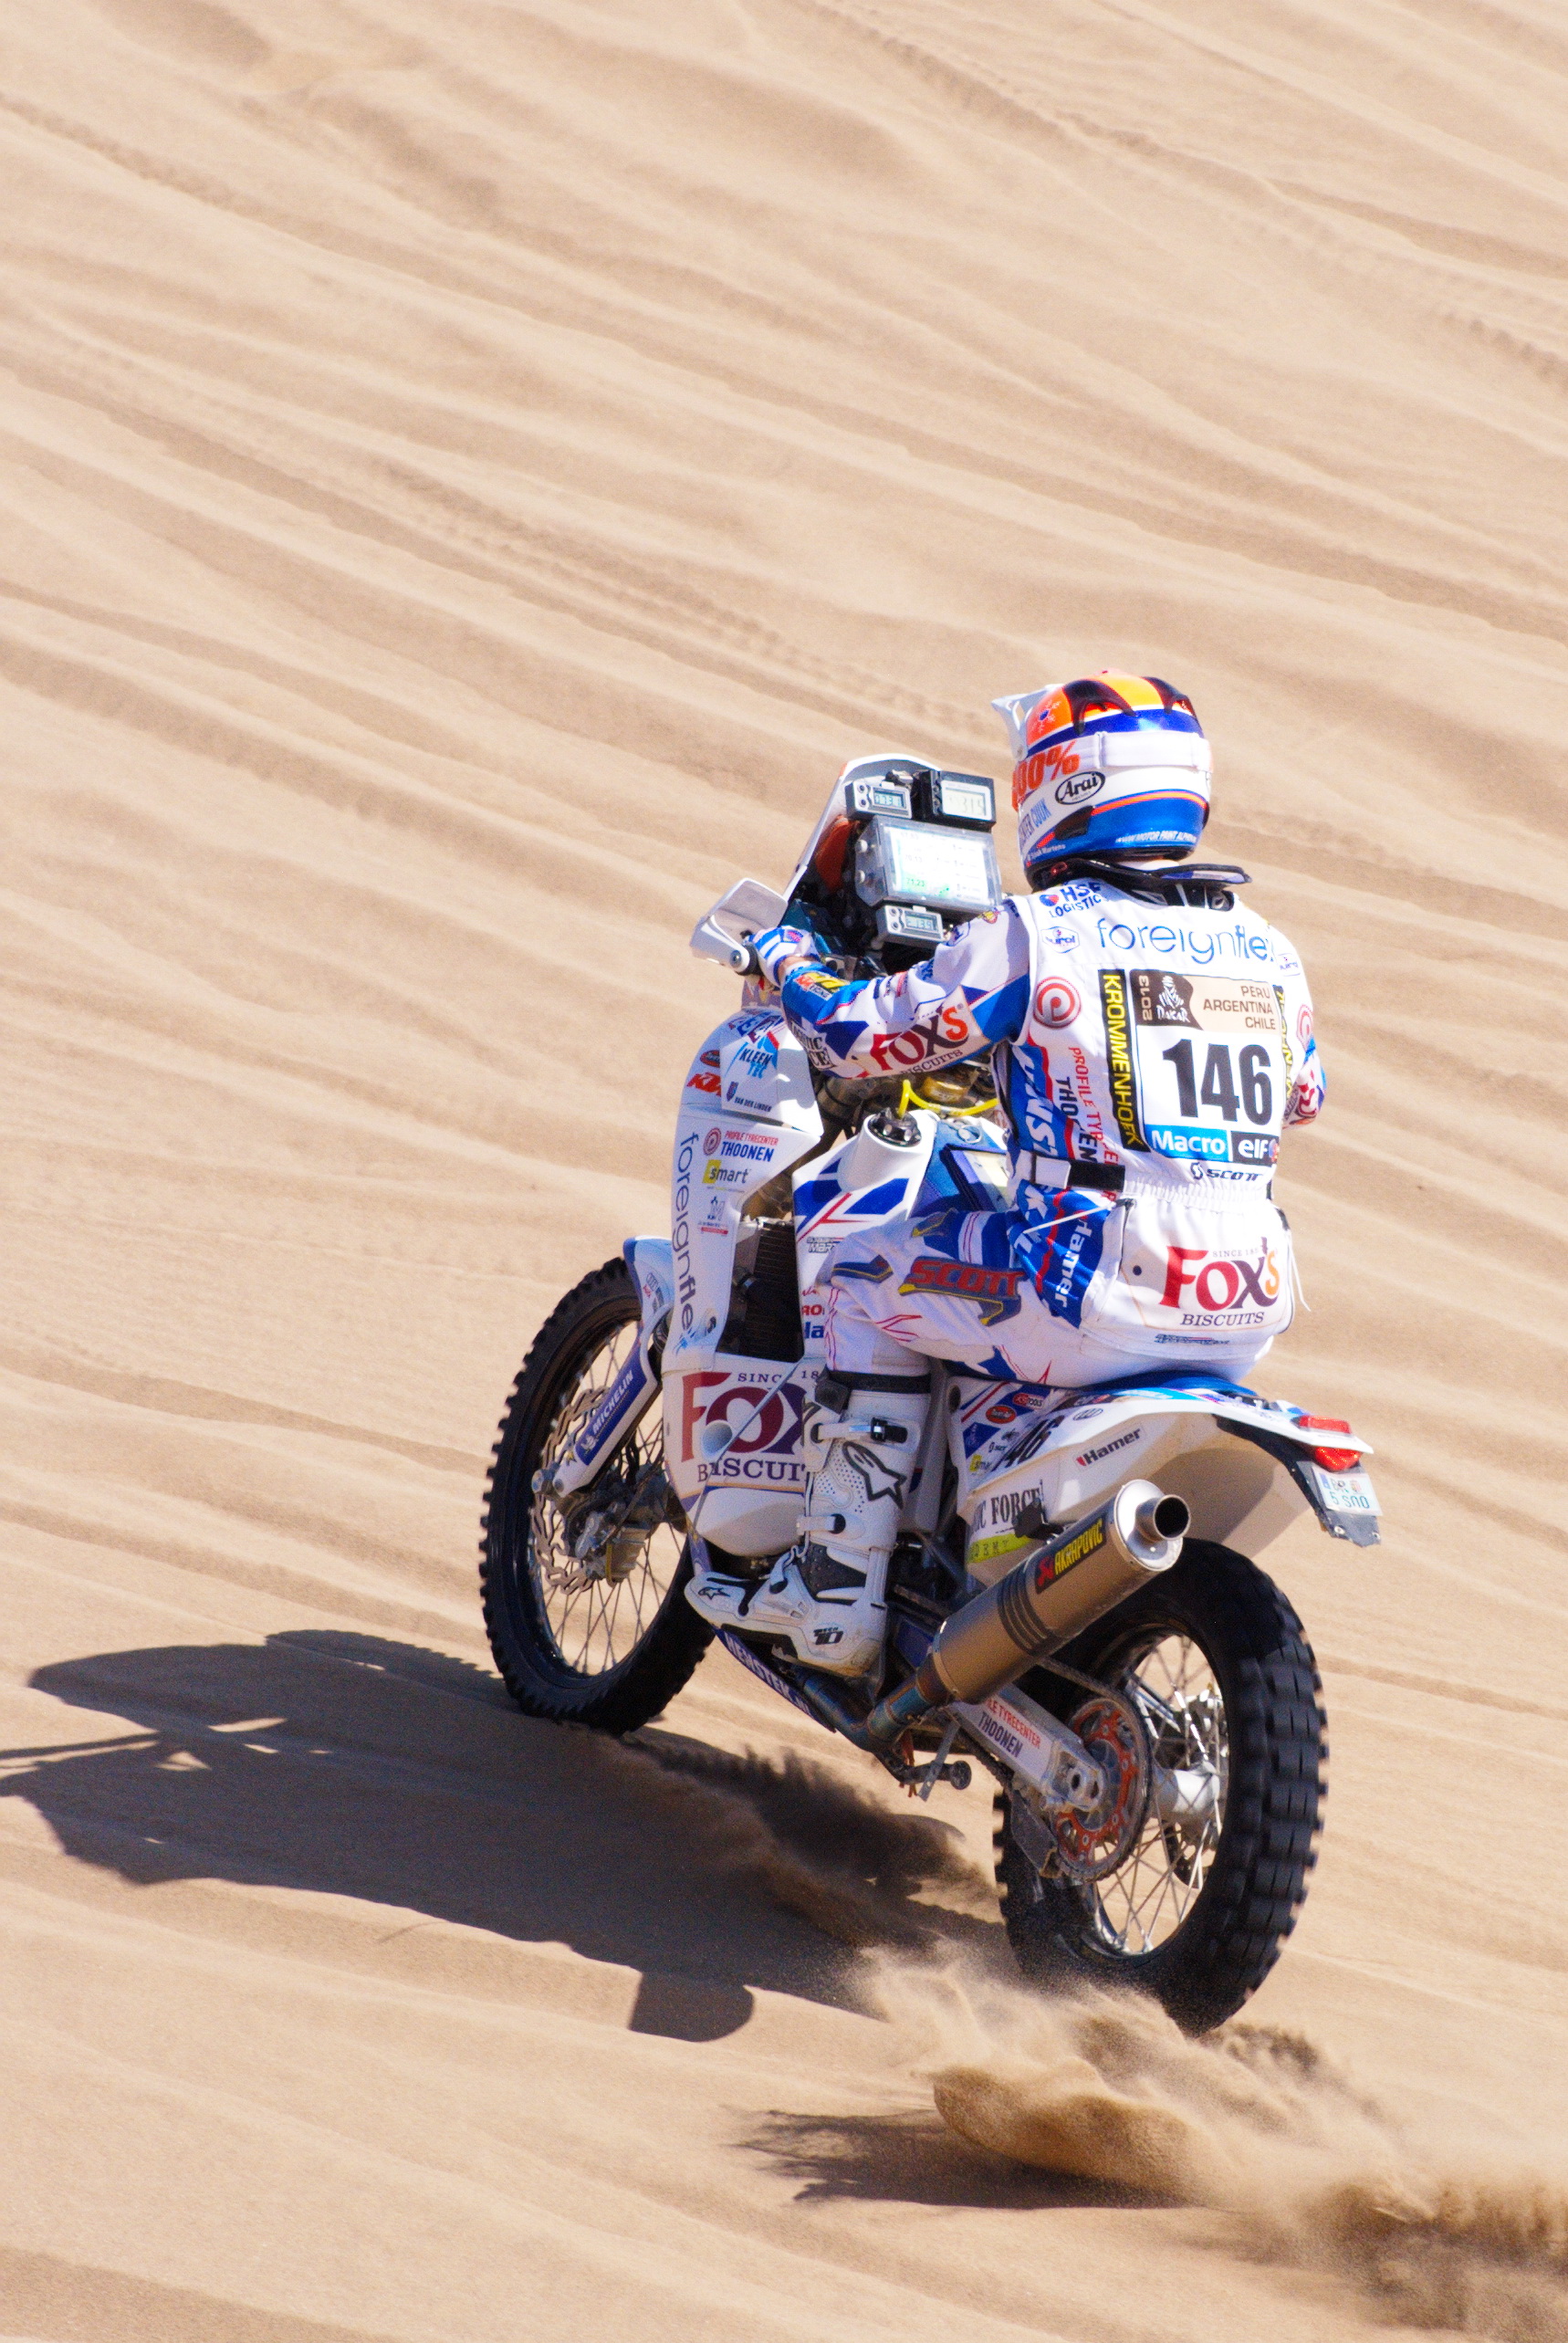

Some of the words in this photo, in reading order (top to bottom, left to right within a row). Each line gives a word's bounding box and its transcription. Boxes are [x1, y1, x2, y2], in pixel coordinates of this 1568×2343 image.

[1060, 771, 1099, 796] Arai
[1240, 985, 1271, 999] PERU
[1203, 998, 1274, 1016] ARGENTINA
[1245, 1016, 1276, 1030] CHILE
[739, 1048, 771, 1069] KLEEN
[1069, 1046, 1096, 1108] PROFILE
[1162, 1038, 1272, 1127] 146
[721, 1142, 775, 1162] THOONEN
[1152, 1129, 1227, 1156] Macro
[1238, 1137, 1269, 1159] elf
[710, 1167, 749, 1184] smart
[912, 1260, 1026, 1296] SCOTT
[1179, 1312, 1265, 1327] BISCUITS
[737, 1372, 785, 1383] SINC
[592, 1369, 634, 1436] MICHELIN
[1085, 1427, 1142, 1466] Hamer
[697, 1458, 806, 1483] BISCUI
[977, 1710, 1024, 1758] THOONEN
